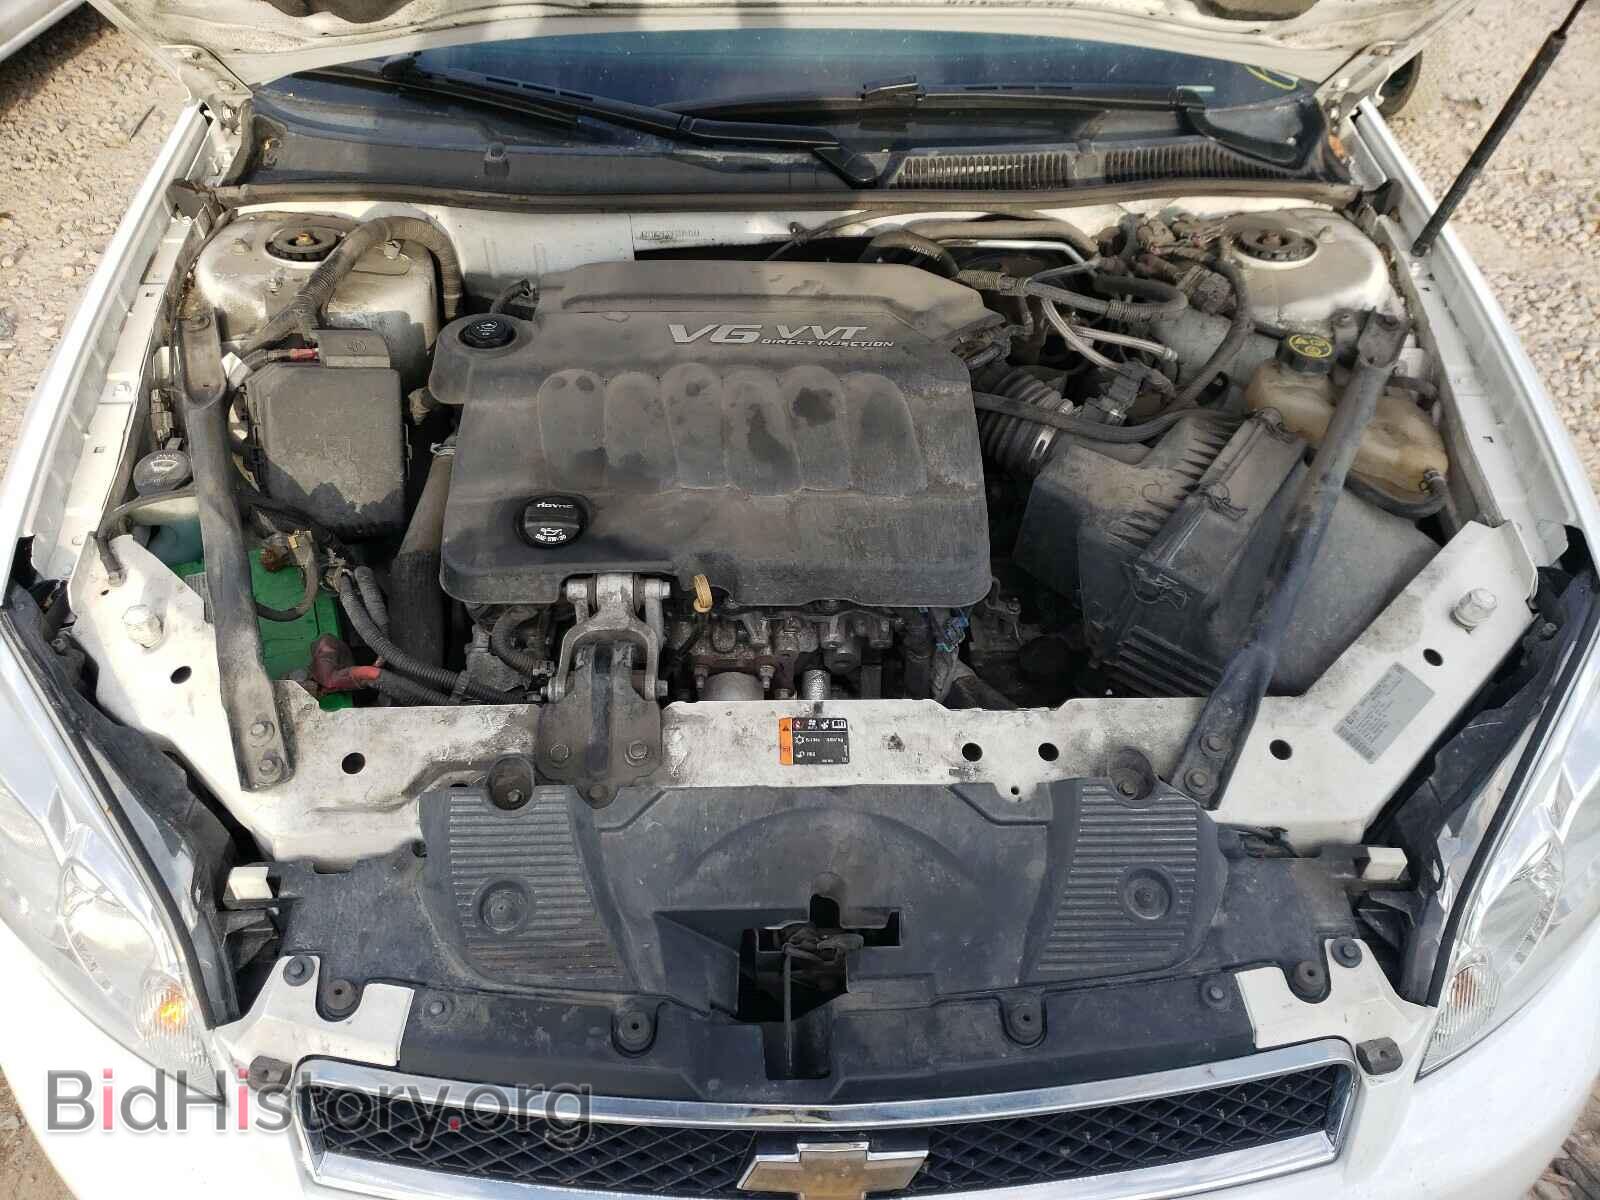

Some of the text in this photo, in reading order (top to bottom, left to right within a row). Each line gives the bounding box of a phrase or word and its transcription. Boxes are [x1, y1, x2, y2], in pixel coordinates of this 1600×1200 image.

[668, 323, 868, 343] V6 VVT
[816, 339, 895, 347] INJECTION
